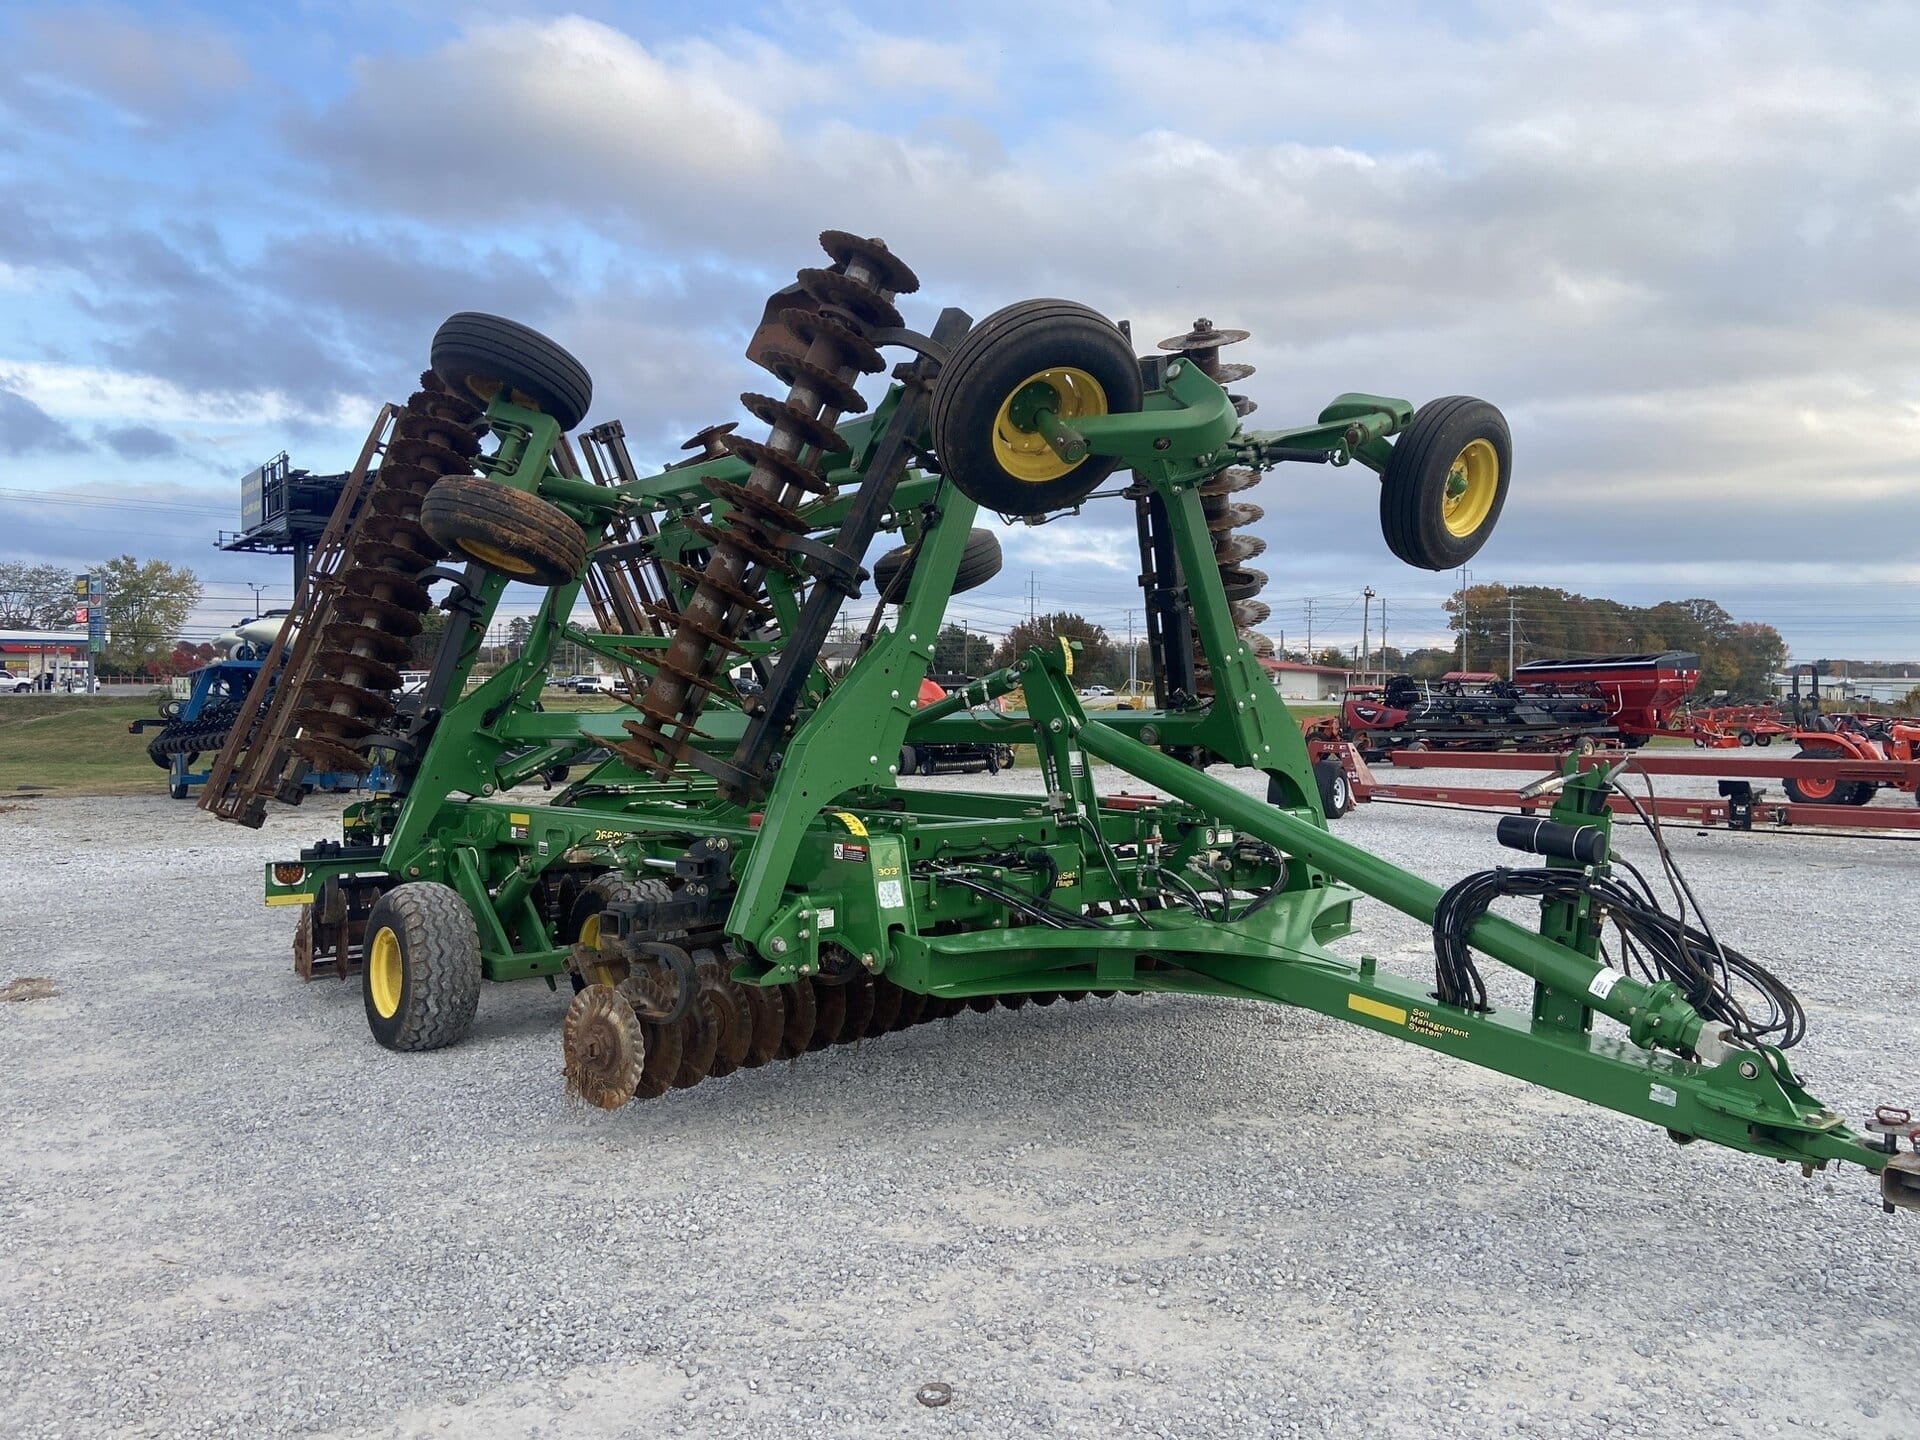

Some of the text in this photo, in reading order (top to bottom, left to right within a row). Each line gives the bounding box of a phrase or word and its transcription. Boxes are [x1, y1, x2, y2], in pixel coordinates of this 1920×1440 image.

[1412, 1008, 1430, 1019] Soil
[1408, 1022, 1442, 1039] System
[1409, 1015, 1470, 1038] Management
